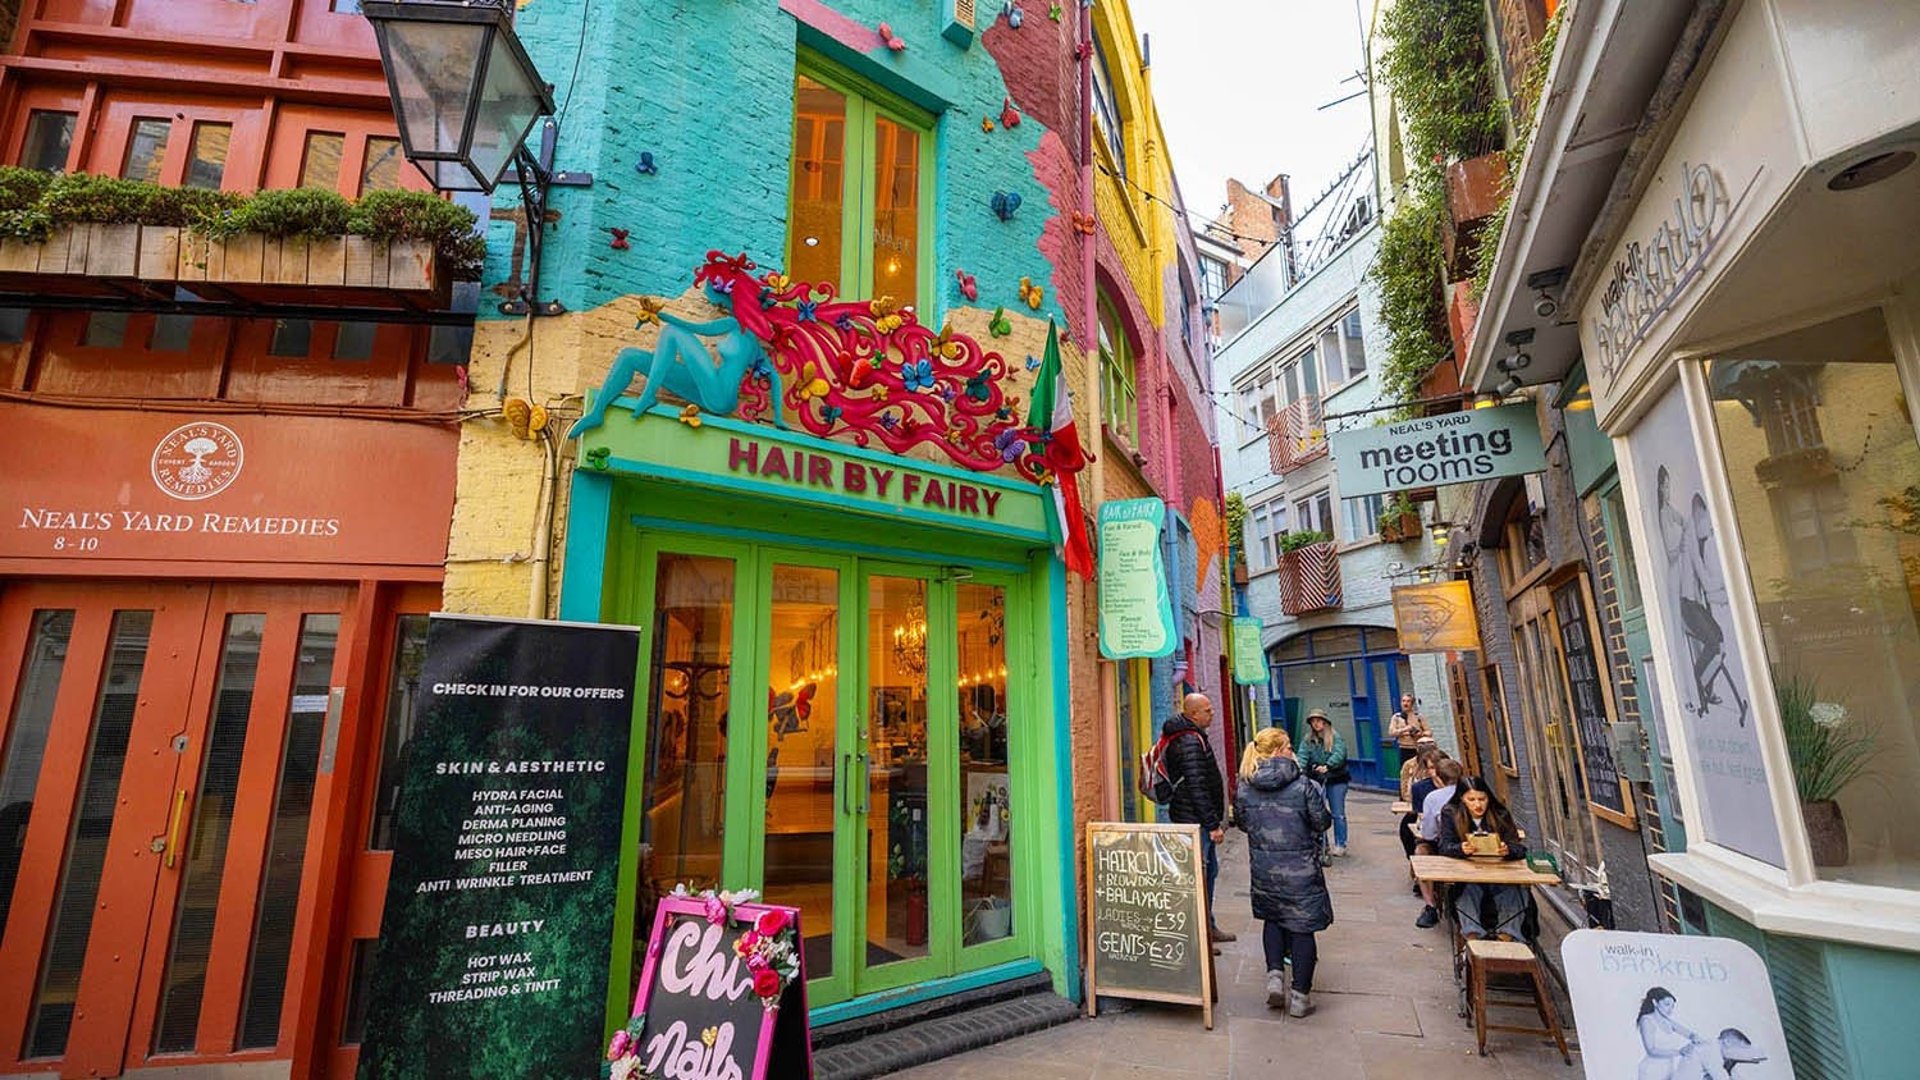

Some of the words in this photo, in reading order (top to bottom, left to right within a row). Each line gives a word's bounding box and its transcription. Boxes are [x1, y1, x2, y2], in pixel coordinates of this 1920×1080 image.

[1600, 242, 1641, 318] walk-in
[1389, 421, 1433, 437] NEAL'S
[1436, 415, 1471, 429] YARD
[162, 427, 208, 456] NEAL'S
[212, 429, 237, 458] YARD
[1360, 428, 1513, 470] meeting
[160, 468, 231, 494] REMEDIES
[728, 438, 833, 488] HAIR
[843, 461, 894, 499] BY
[902, 473, 1002, 517] FAIRY
[1384, 454, 1494, 488] rooms
[19, 507, 113, 531] NEAL'S
[119, 510, 194, 533] YARD
[200, 512, 340, 537] REMEDIES
[432, 682, 489, 697] CHECK
[490, 684, 506, 697] IN
[508, 685, 539, 698] FOR
[541, 686, 573, 698] OUR
[575, 687, 625, 700] OFFERS
[436, 762, 483, 775] SKIN
[487, 761, 501, 775] &
[505, 760, 605, 774] AESTHETIC
[472, 790, 517, 802] HYDRA
[519, 789, 564, 801] FACIAL
[474, 803, 554, 816] ANTI-AGING
[462, 819, 509, 831] DERMA
[511, 816, 566, 829] PLANING
[458, 833, 504, 845] MICRO
[506, 830, 566, 843] NEEDLING
[454, 848, 493, 861] MESO
[488, 861, 529, 873] FILLER
[416, 879, 450, 894] ANTI
[456, 876, 515, 890] WRINKLE
[519, 870, 594, 886] TREATMENT
[1106, 887, 1171, 910] BALAYAGE
[465, 919, 544, 939] BEAUTY
[1098, 908, 1140, 922] LADIES
[1154, 911, 1187, 931] £39
[1098, 931, 1146, 956] GENTS
[1149, 941, 1185, 963] £29
[1604, 943, 1654, 958] walk-in
[467, 955, 498, 969] HOT
[499, 952, 533, 966] WAX
[1599, 946, 1729, 982] backrub
[462, 971, 501, 985] STRIP
[503, 967, 536, 981] WAX
[429, 986, 508, 1004] THREADING
[511, 983, 521, 996] &
[524, 979, 561, 993] TINTT
